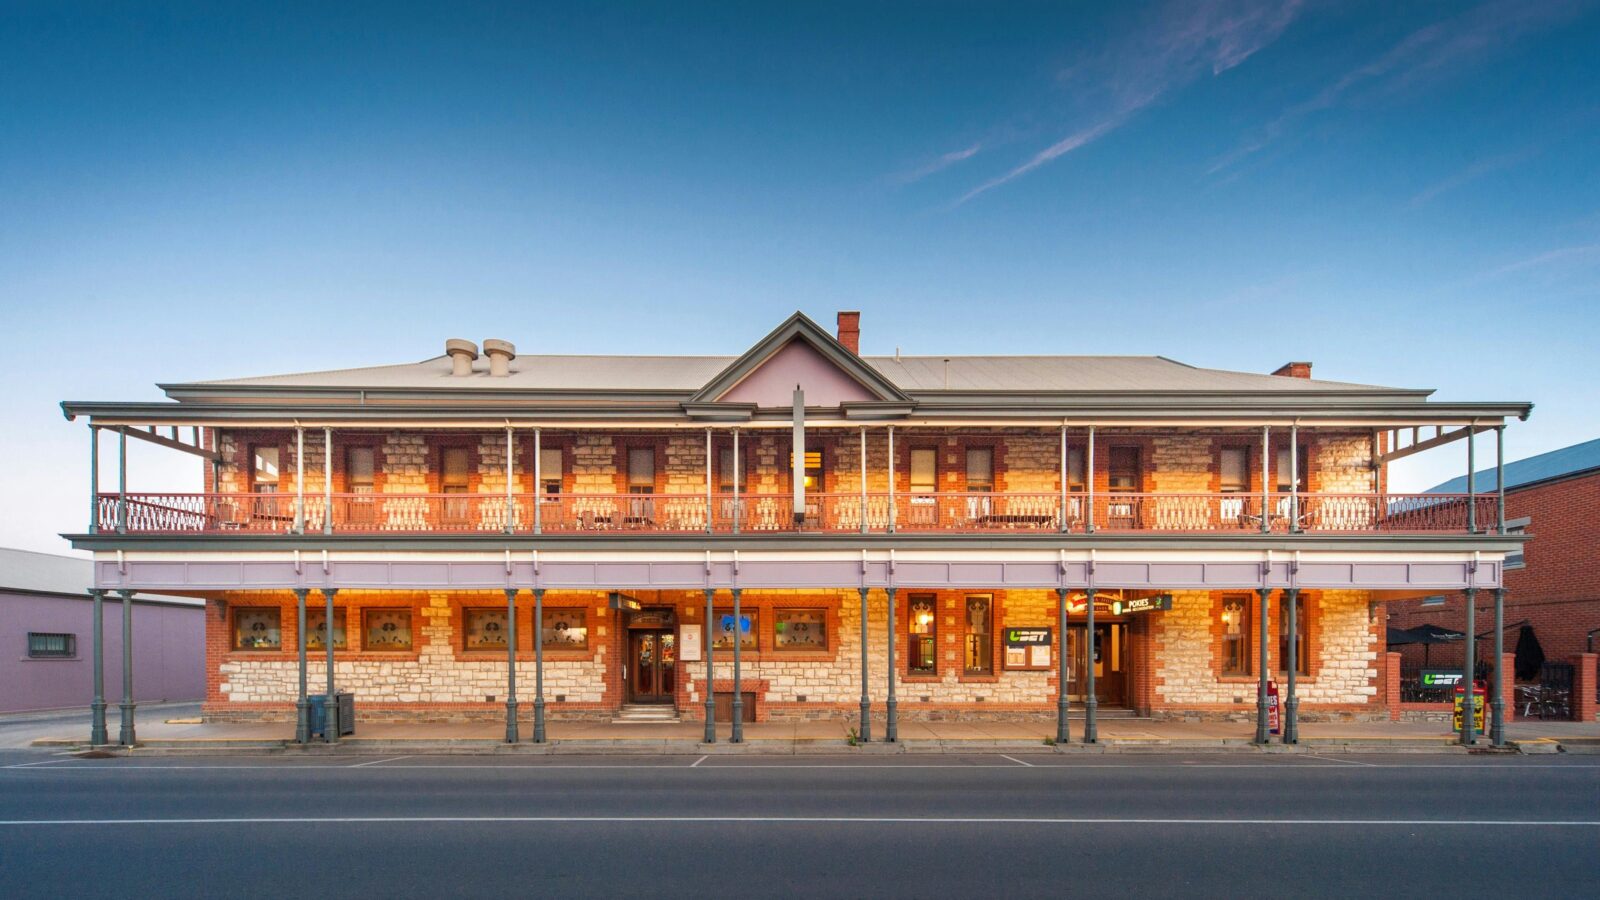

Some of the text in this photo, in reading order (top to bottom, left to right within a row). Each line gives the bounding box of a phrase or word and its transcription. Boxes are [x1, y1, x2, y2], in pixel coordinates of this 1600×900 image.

[1129, 598, 1149, 608] POKIES
[1010, 631, 1048, 641] UBET
[1424, 674, 1463, 684] UBET
[1455, 708, 1482, 717] NW
